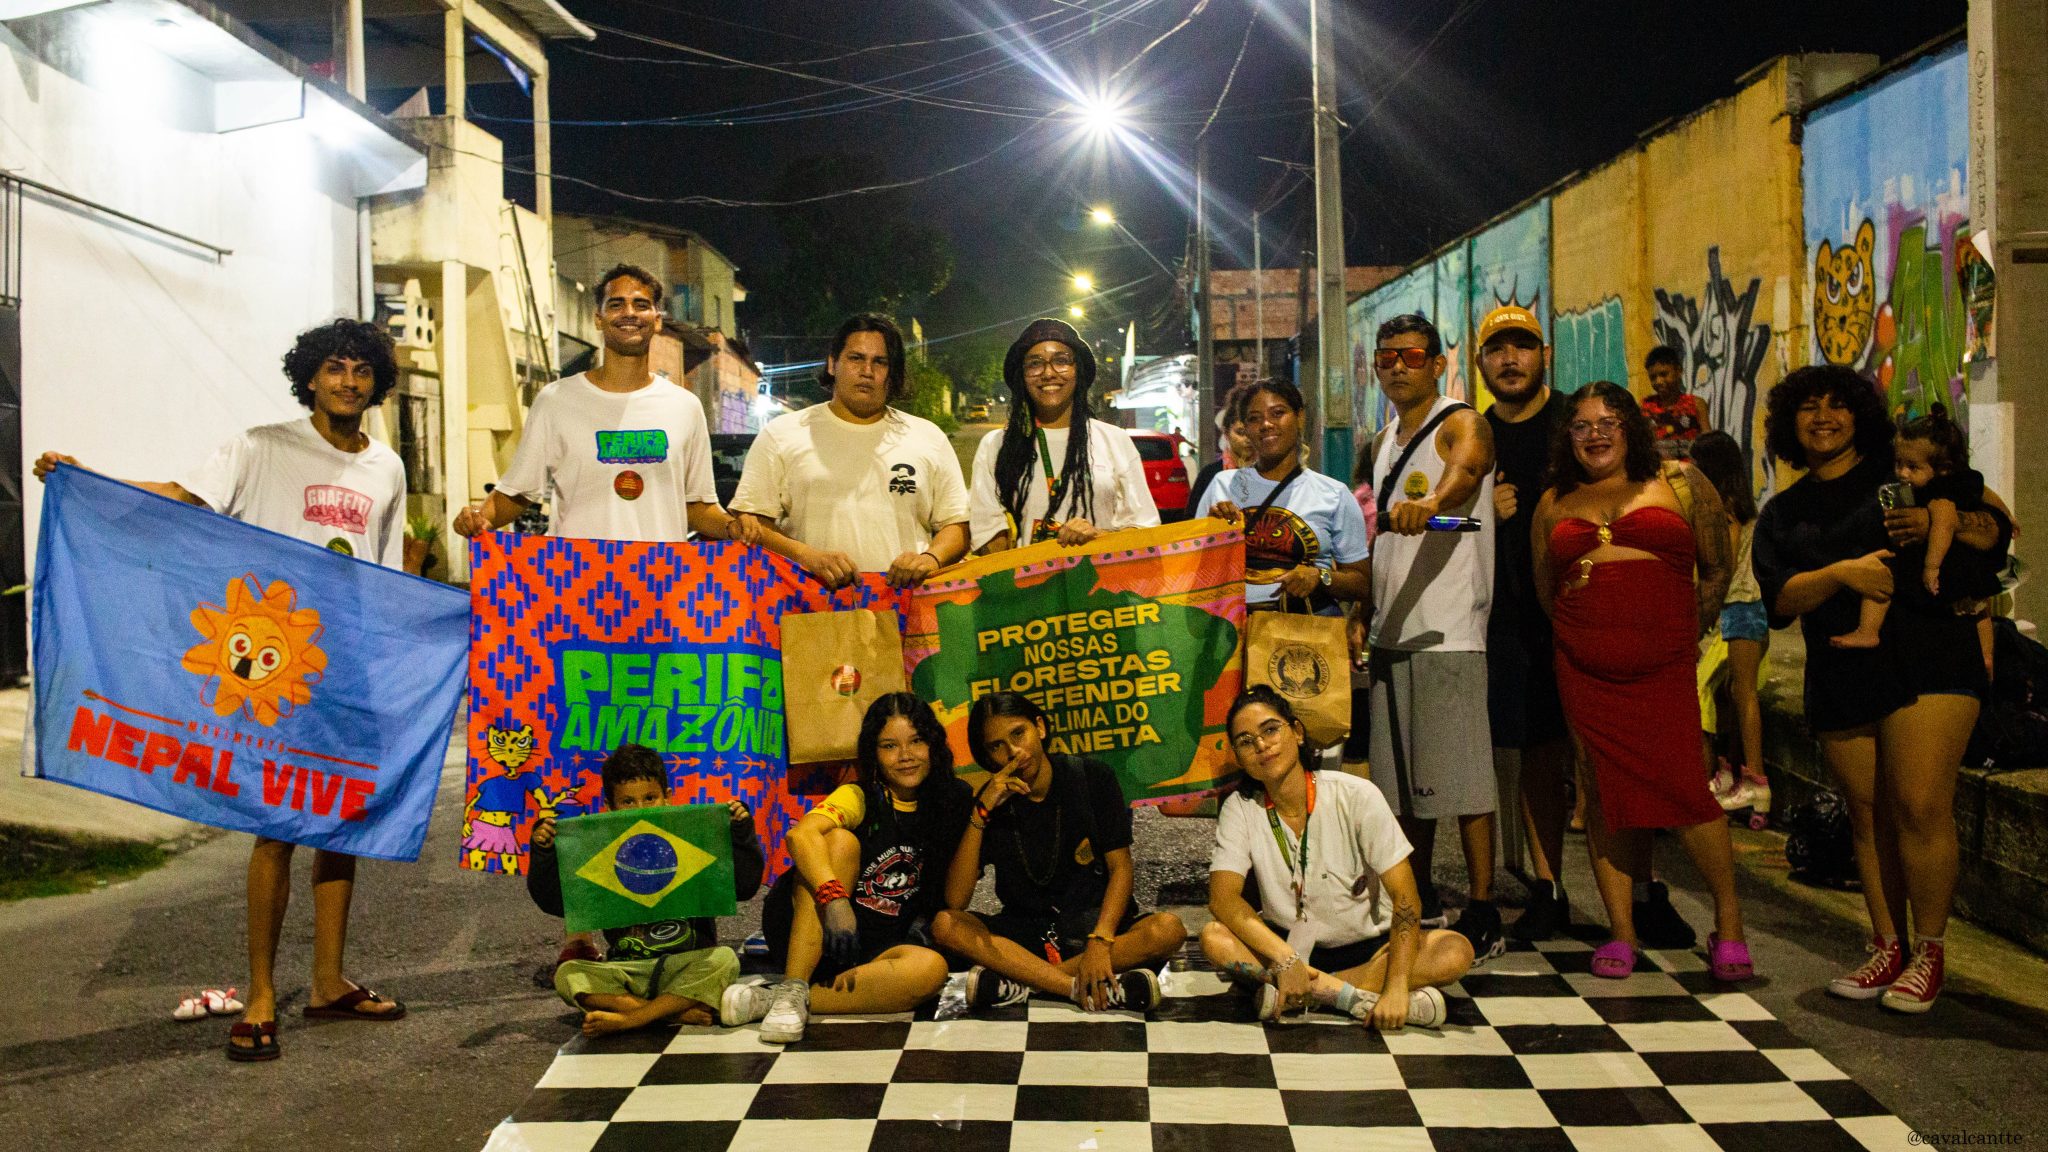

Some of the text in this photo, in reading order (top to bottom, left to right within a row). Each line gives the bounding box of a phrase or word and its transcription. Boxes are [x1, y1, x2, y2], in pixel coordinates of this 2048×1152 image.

[977, 602, 1160, 652] PROTEGER
[1024, 632, 1119, 667] NOSSAS
[971, 649, 1172, 702] FLORESTAS
[1024, 672, 1182, 711] EFENDER
[559, 697, 784, 759] AMAZÔNIA
[1115, 701, 1149, 724] DO
[1048, 724, 1162, 756] ANETA
[67, 706, 376, 822] NEPAL VIVE
